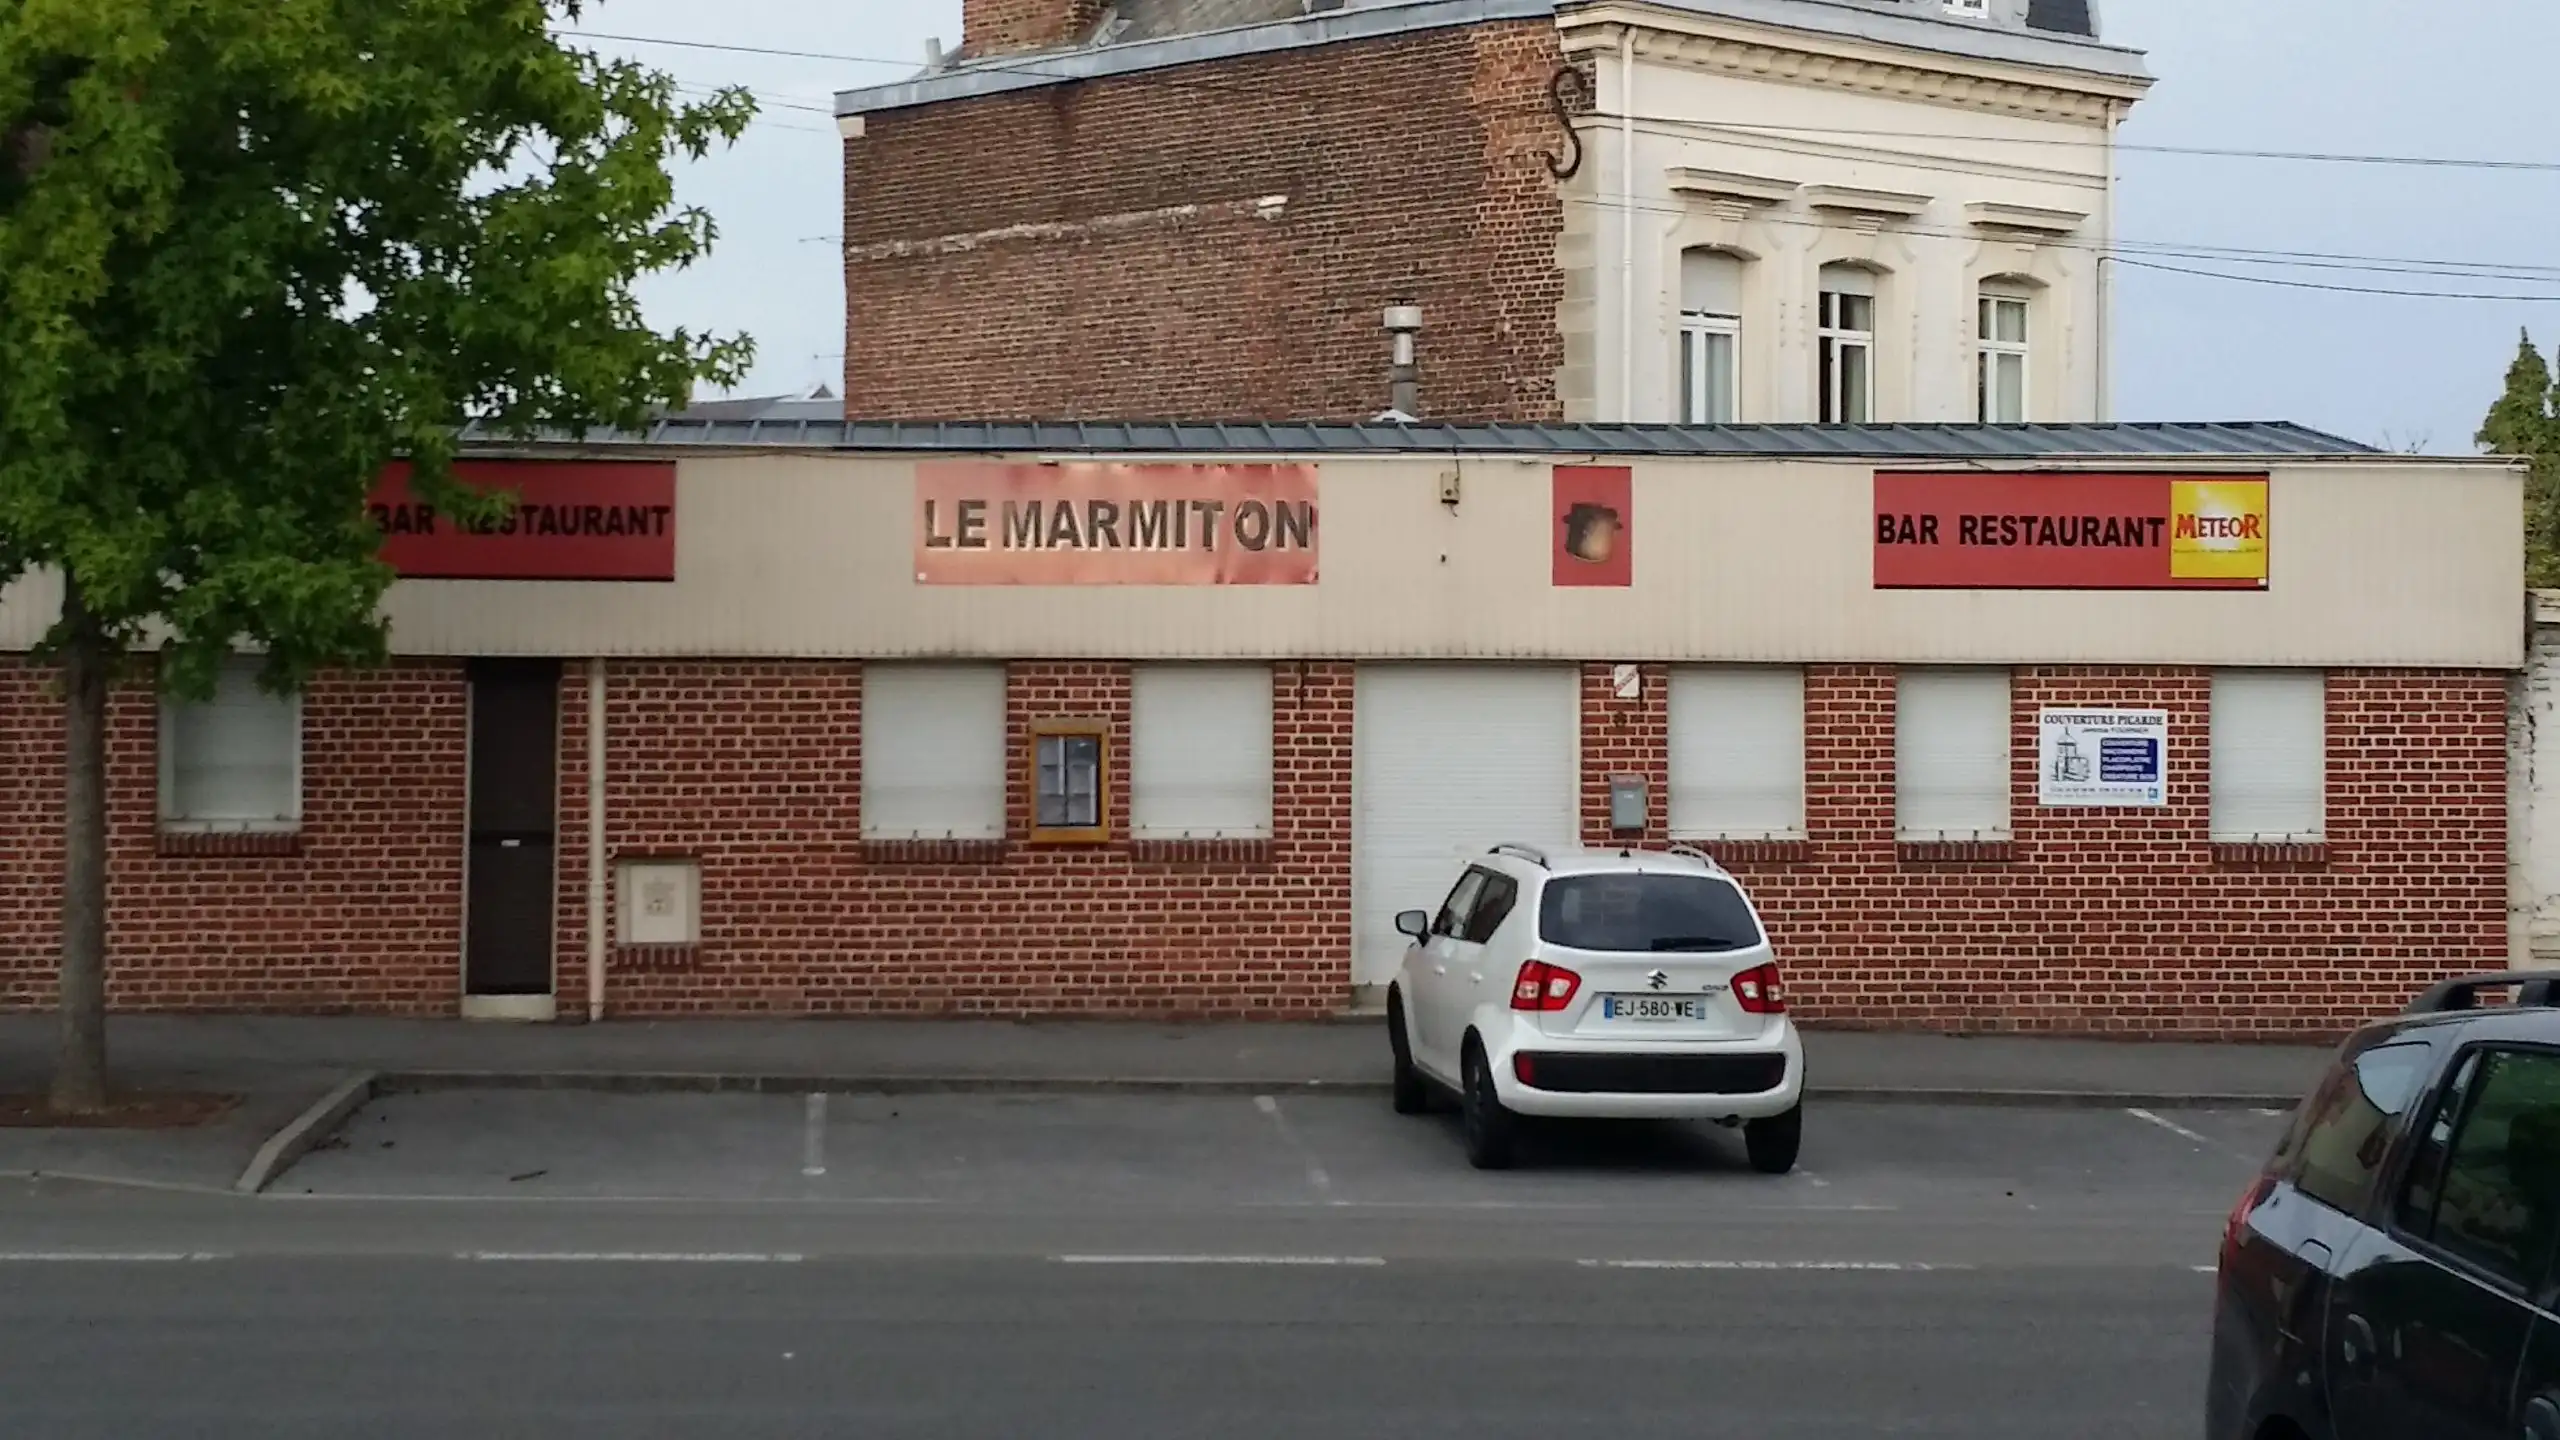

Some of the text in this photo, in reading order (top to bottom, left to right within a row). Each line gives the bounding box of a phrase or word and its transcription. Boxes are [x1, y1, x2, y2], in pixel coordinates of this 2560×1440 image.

[369, 503, 435, 536] BAR
[924, 499, 1313, 551] LE MARMITON
[1877, 513, 2166, 548] BAR RESTAURANT
[2175, 512, 2263, 539] METEOR
[2043, 714, 2164, 726] COUVERTURE PICARDE
